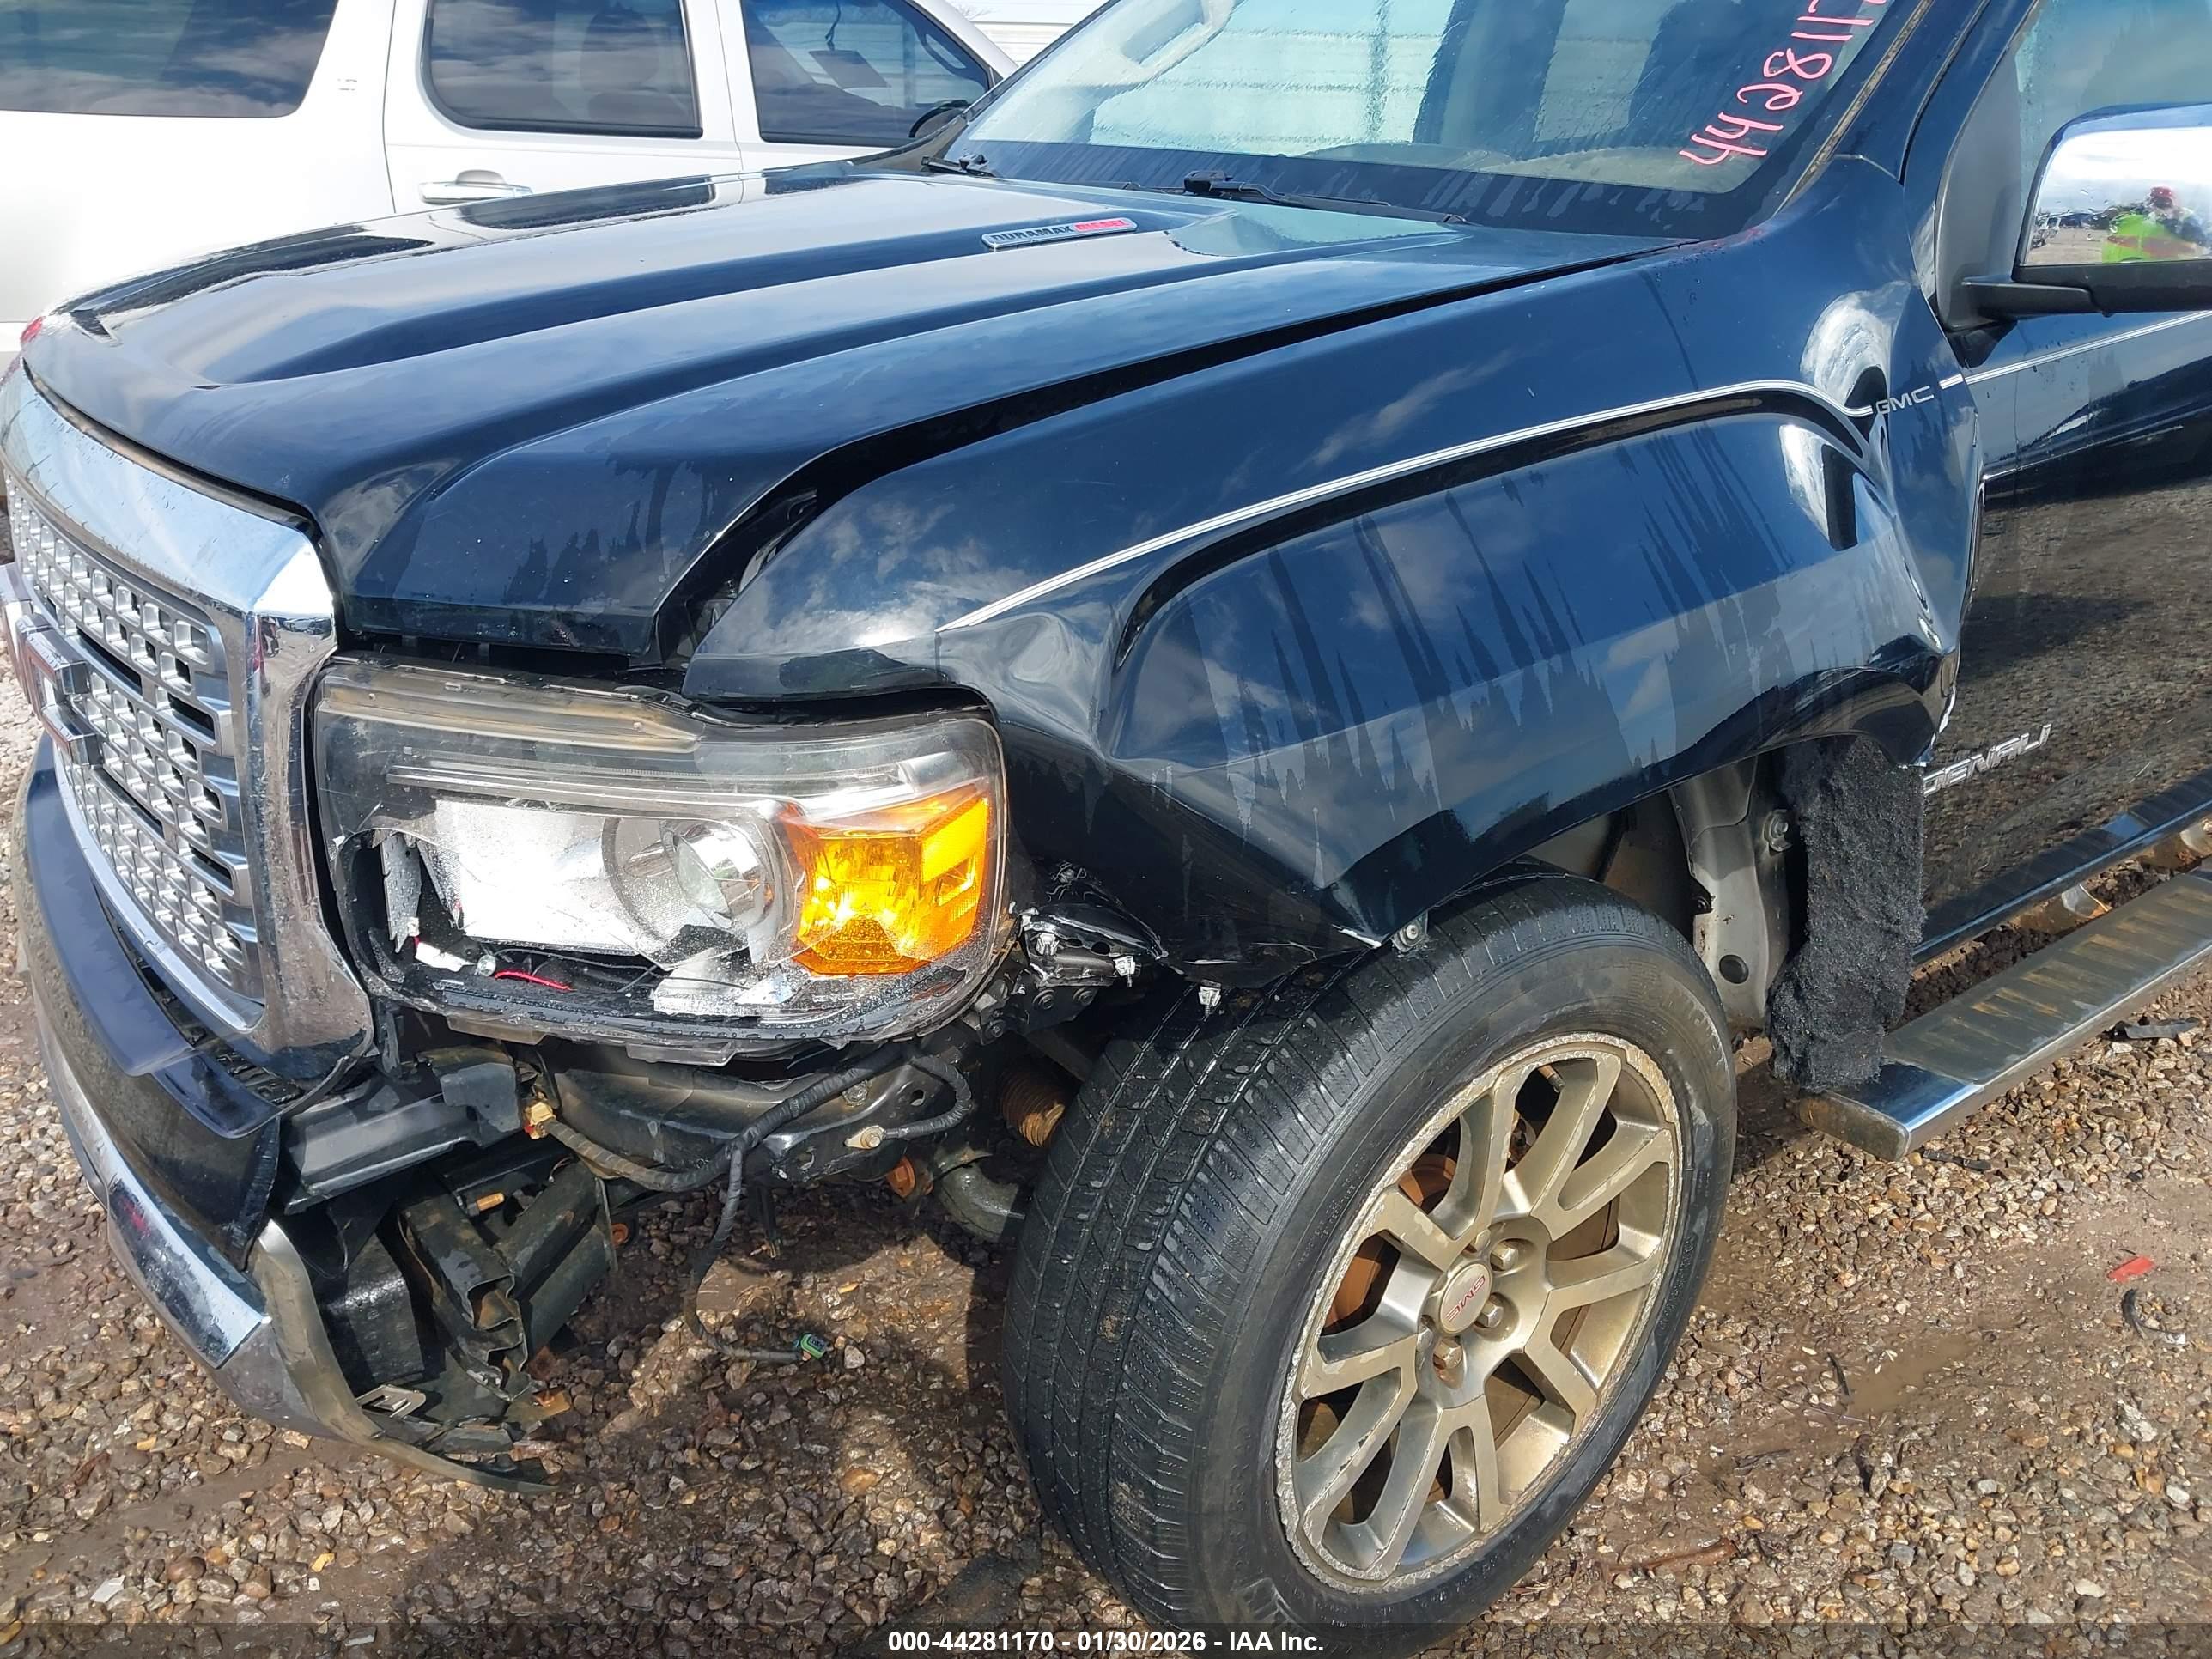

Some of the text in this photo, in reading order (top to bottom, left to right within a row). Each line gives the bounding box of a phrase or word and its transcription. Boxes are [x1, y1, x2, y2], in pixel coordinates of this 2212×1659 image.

[1679, 0, 1887, 165] 442811
[991, 219, 1129, 241] DURAMAX DIESEL
[1875, 385, 1935, 415] GMC
[1445, 1274, 1486, 1323] GMC
